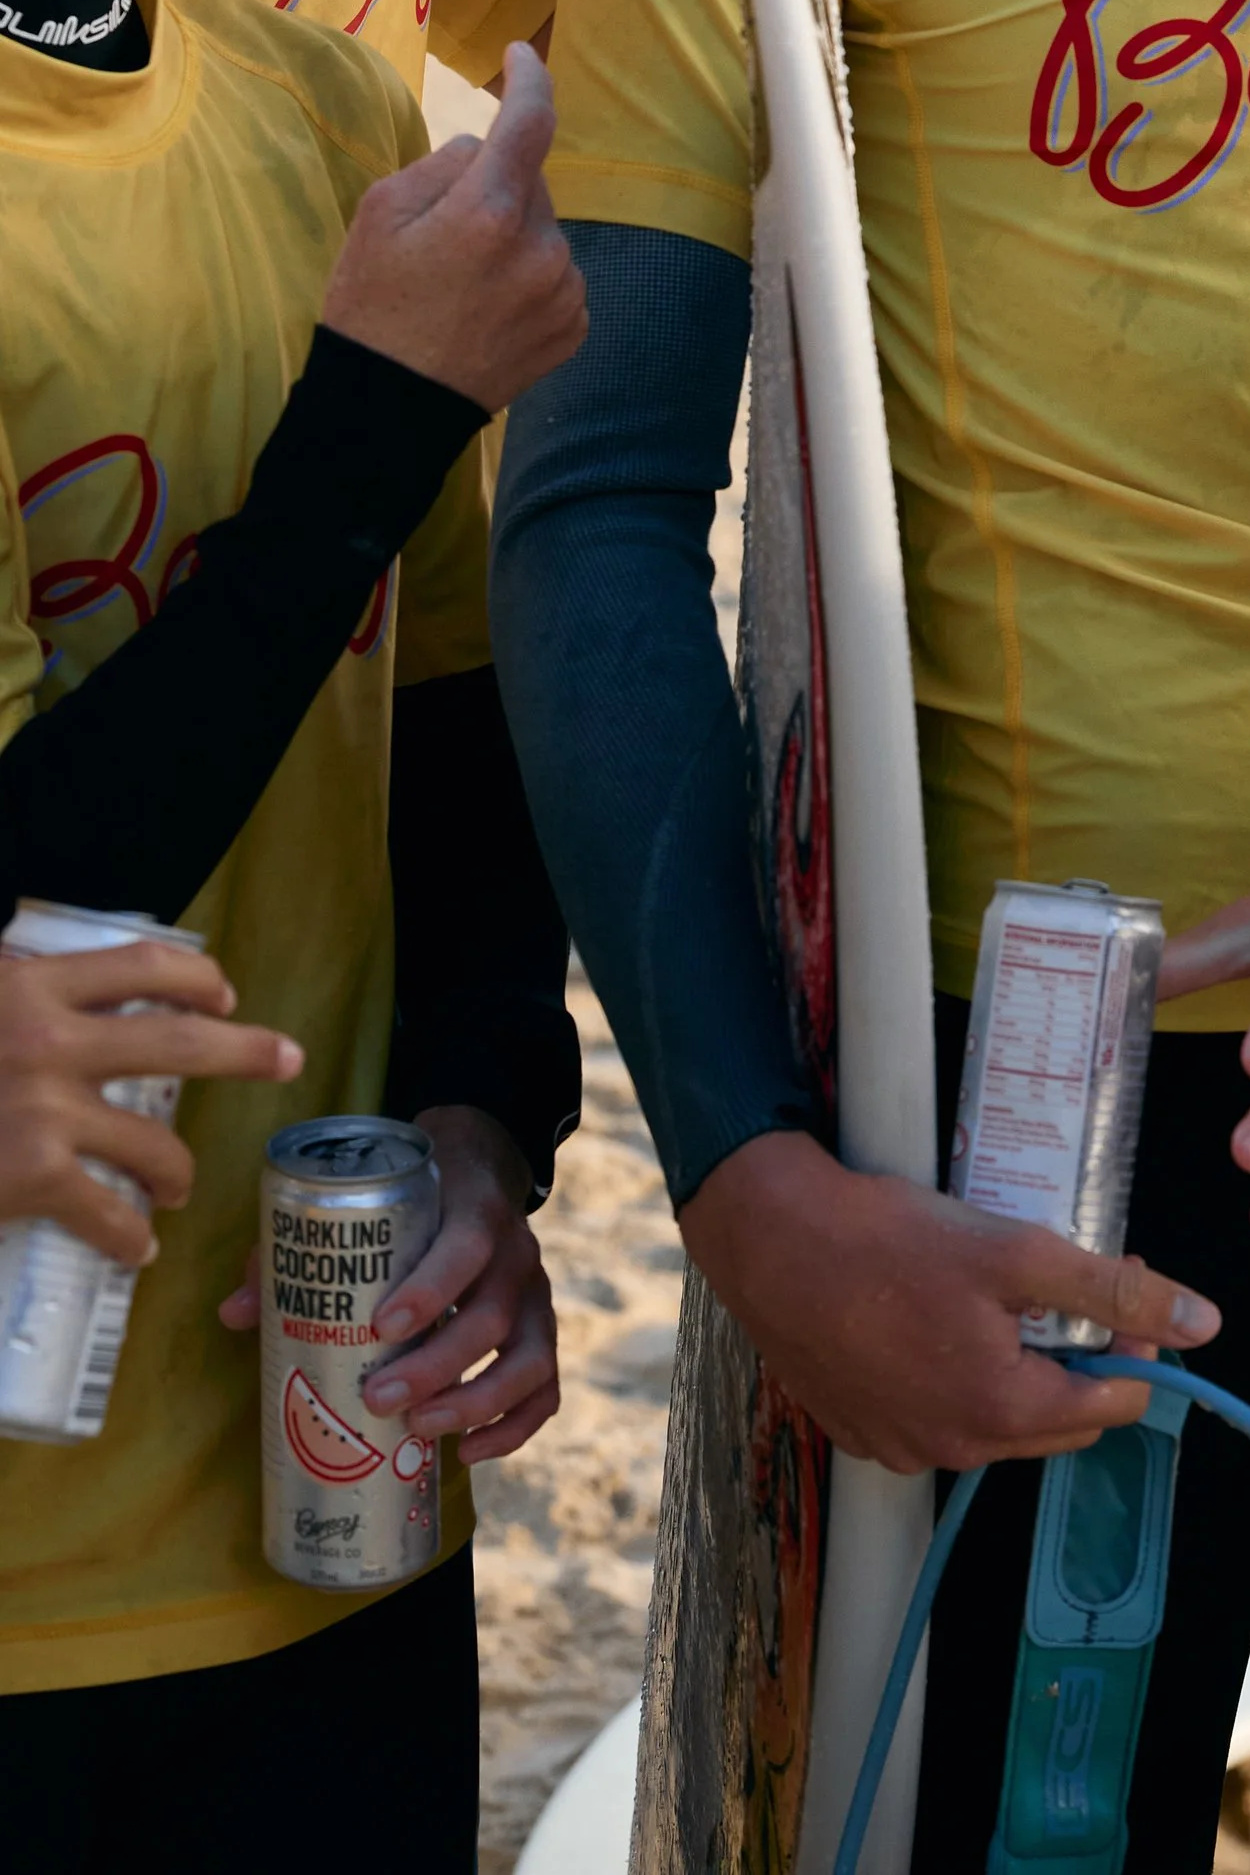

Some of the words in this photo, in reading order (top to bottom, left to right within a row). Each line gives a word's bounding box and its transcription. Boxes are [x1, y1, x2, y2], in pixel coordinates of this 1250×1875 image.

[272, 1209, 391, 1249] SPARKLING
[272, 1244, 394, 1286] COCONUT
[273, 1279, 354, 1322] WATER
[282, 1321, 381, 1347] WATERMELON
